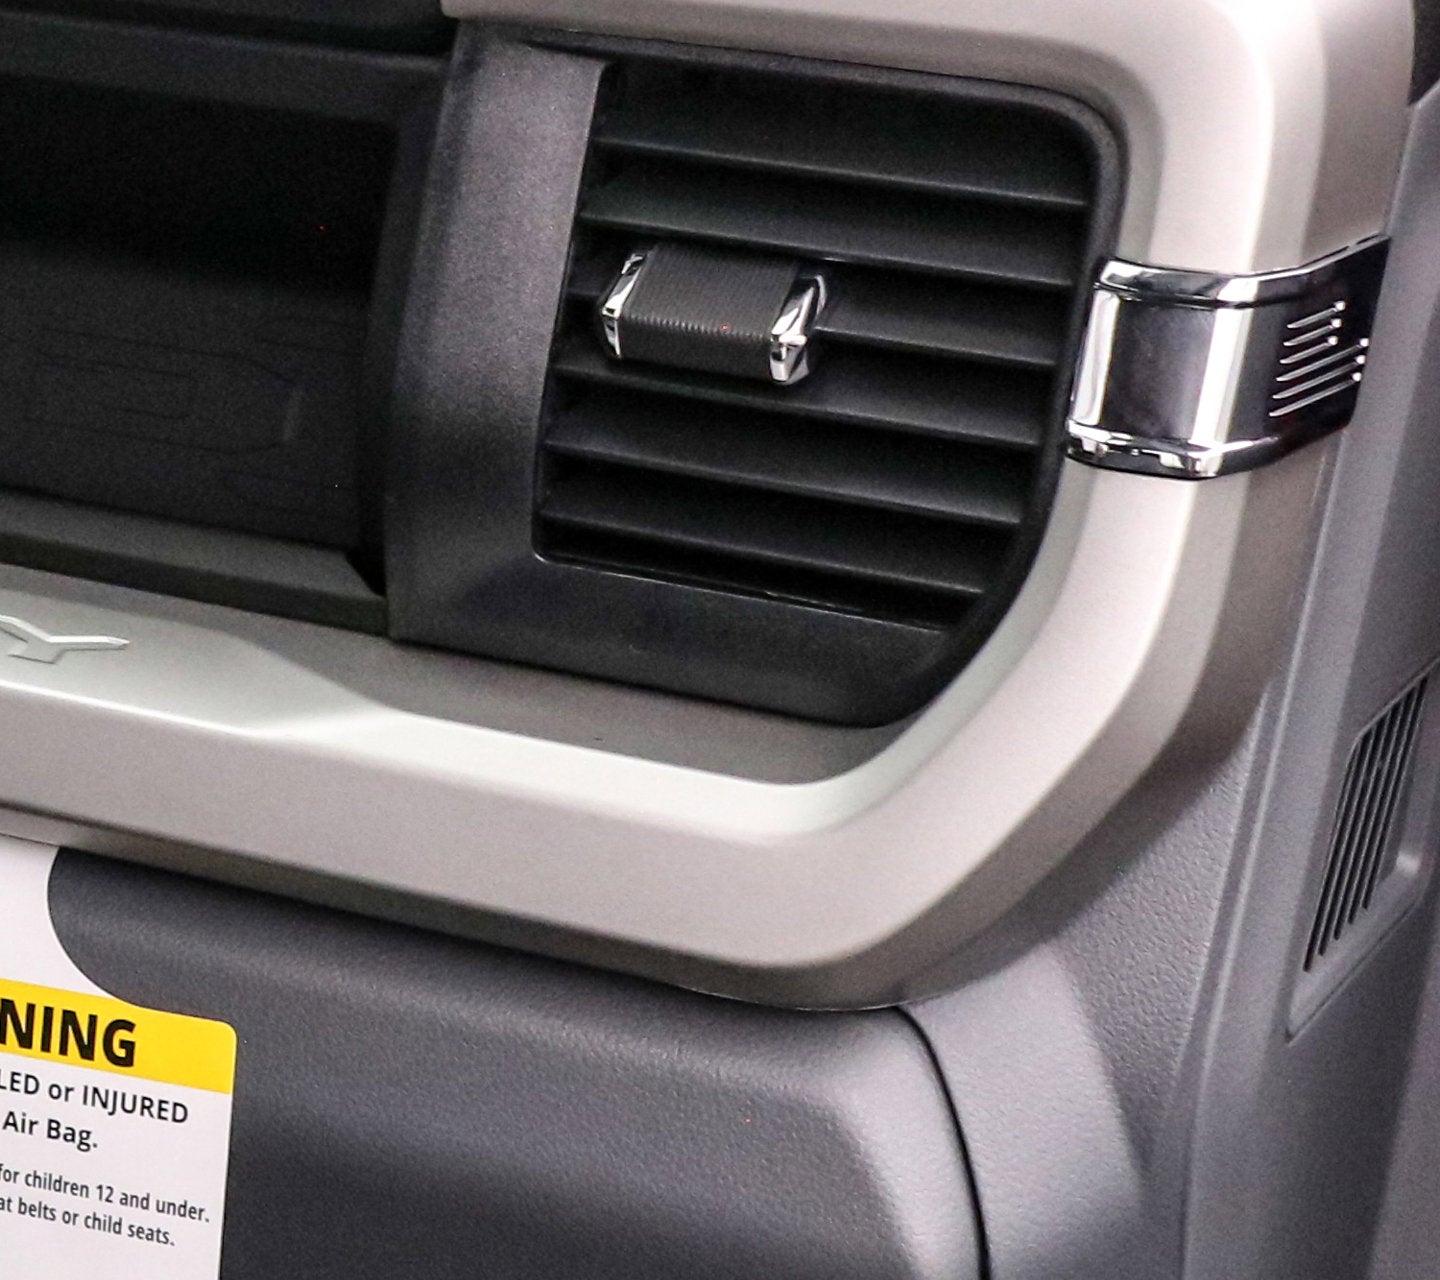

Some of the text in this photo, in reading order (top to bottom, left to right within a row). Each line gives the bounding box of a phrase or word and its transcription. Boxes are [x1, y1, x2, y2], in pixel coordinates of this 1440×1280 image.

[48, 1083, 75, 1102] or
[82, 1085, 189, 1124] INJURED
[2, 1110, 39, 1135] Air
[46, 1118, 98, 1153] Bag.
[24, 1169, 90, 1199] children
[96, 1184, 114, 1204] 12
[119, 1192, 151, 1211] and
[155, 1199, 210, 1223] under.
[17, 1196, 57, 1222] belts
[61, 1210, 80, 1226] or
[83, 1211, 123, 1235] child
[127, 1224, 175, 1246] seats.
